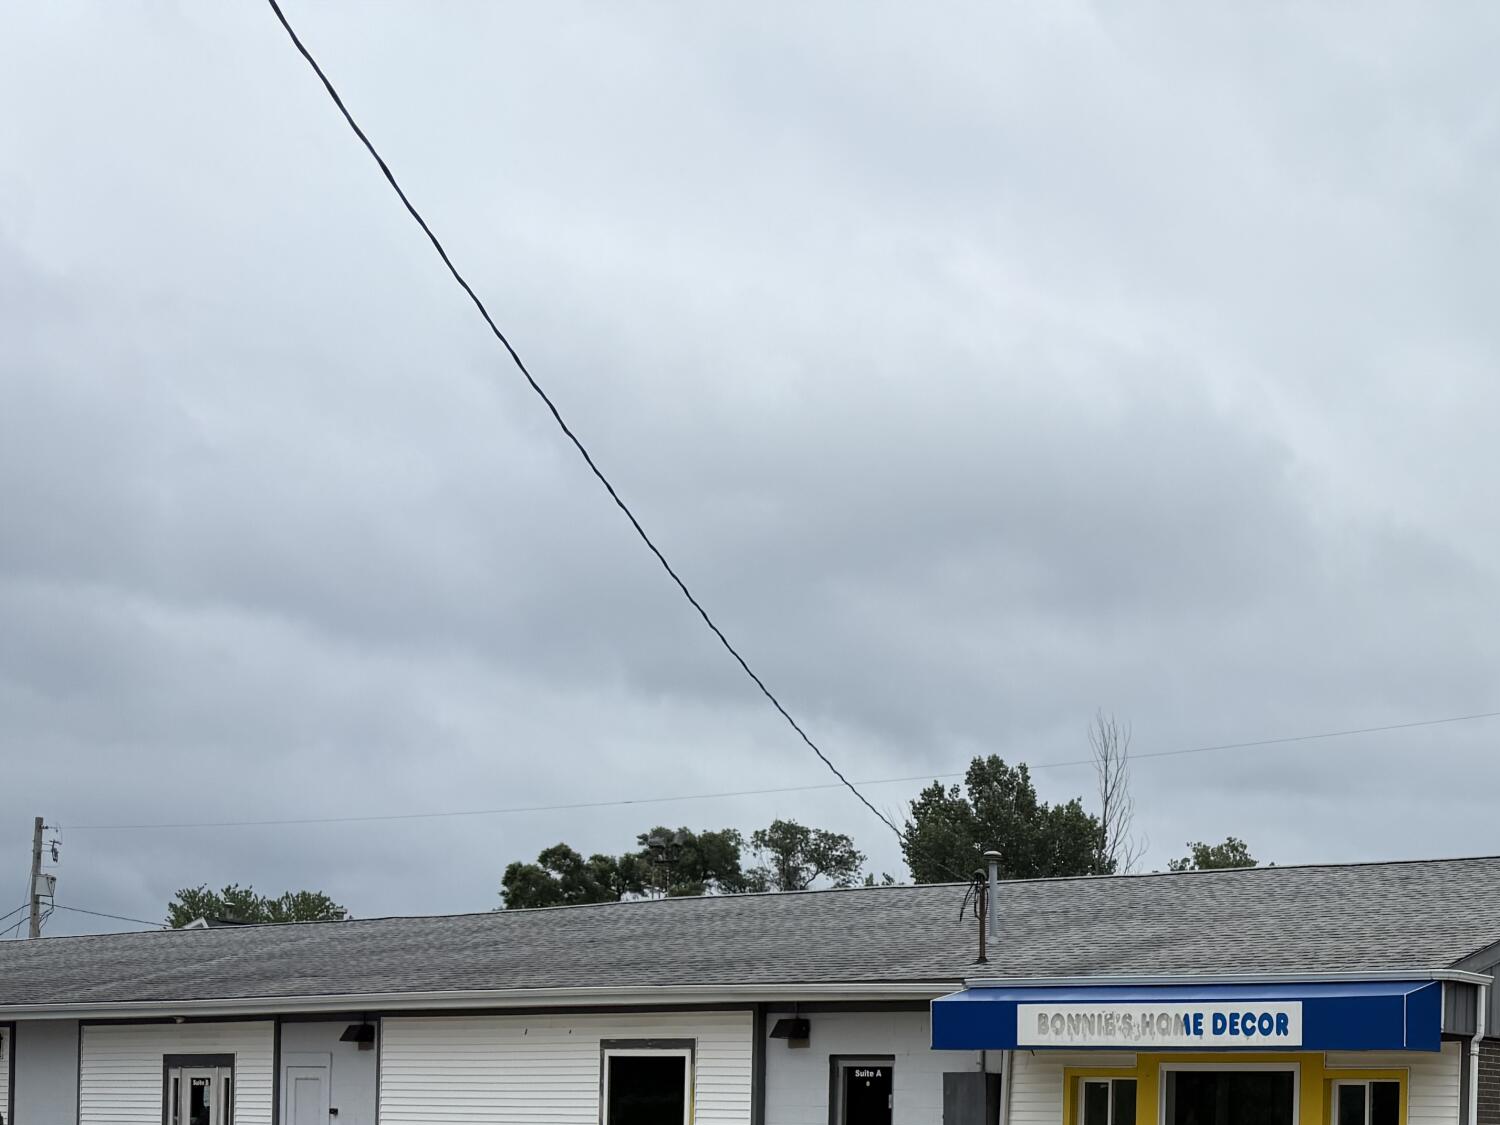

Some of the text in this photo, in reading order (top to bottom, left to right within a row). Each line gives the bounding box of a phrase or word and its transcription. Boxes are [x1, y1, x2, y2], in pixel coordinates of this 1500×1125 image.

[1038, 1012, 1289, 1039] BONNIE'S HOME DECOR
[855, 1069, 882, 1077] Suite A
